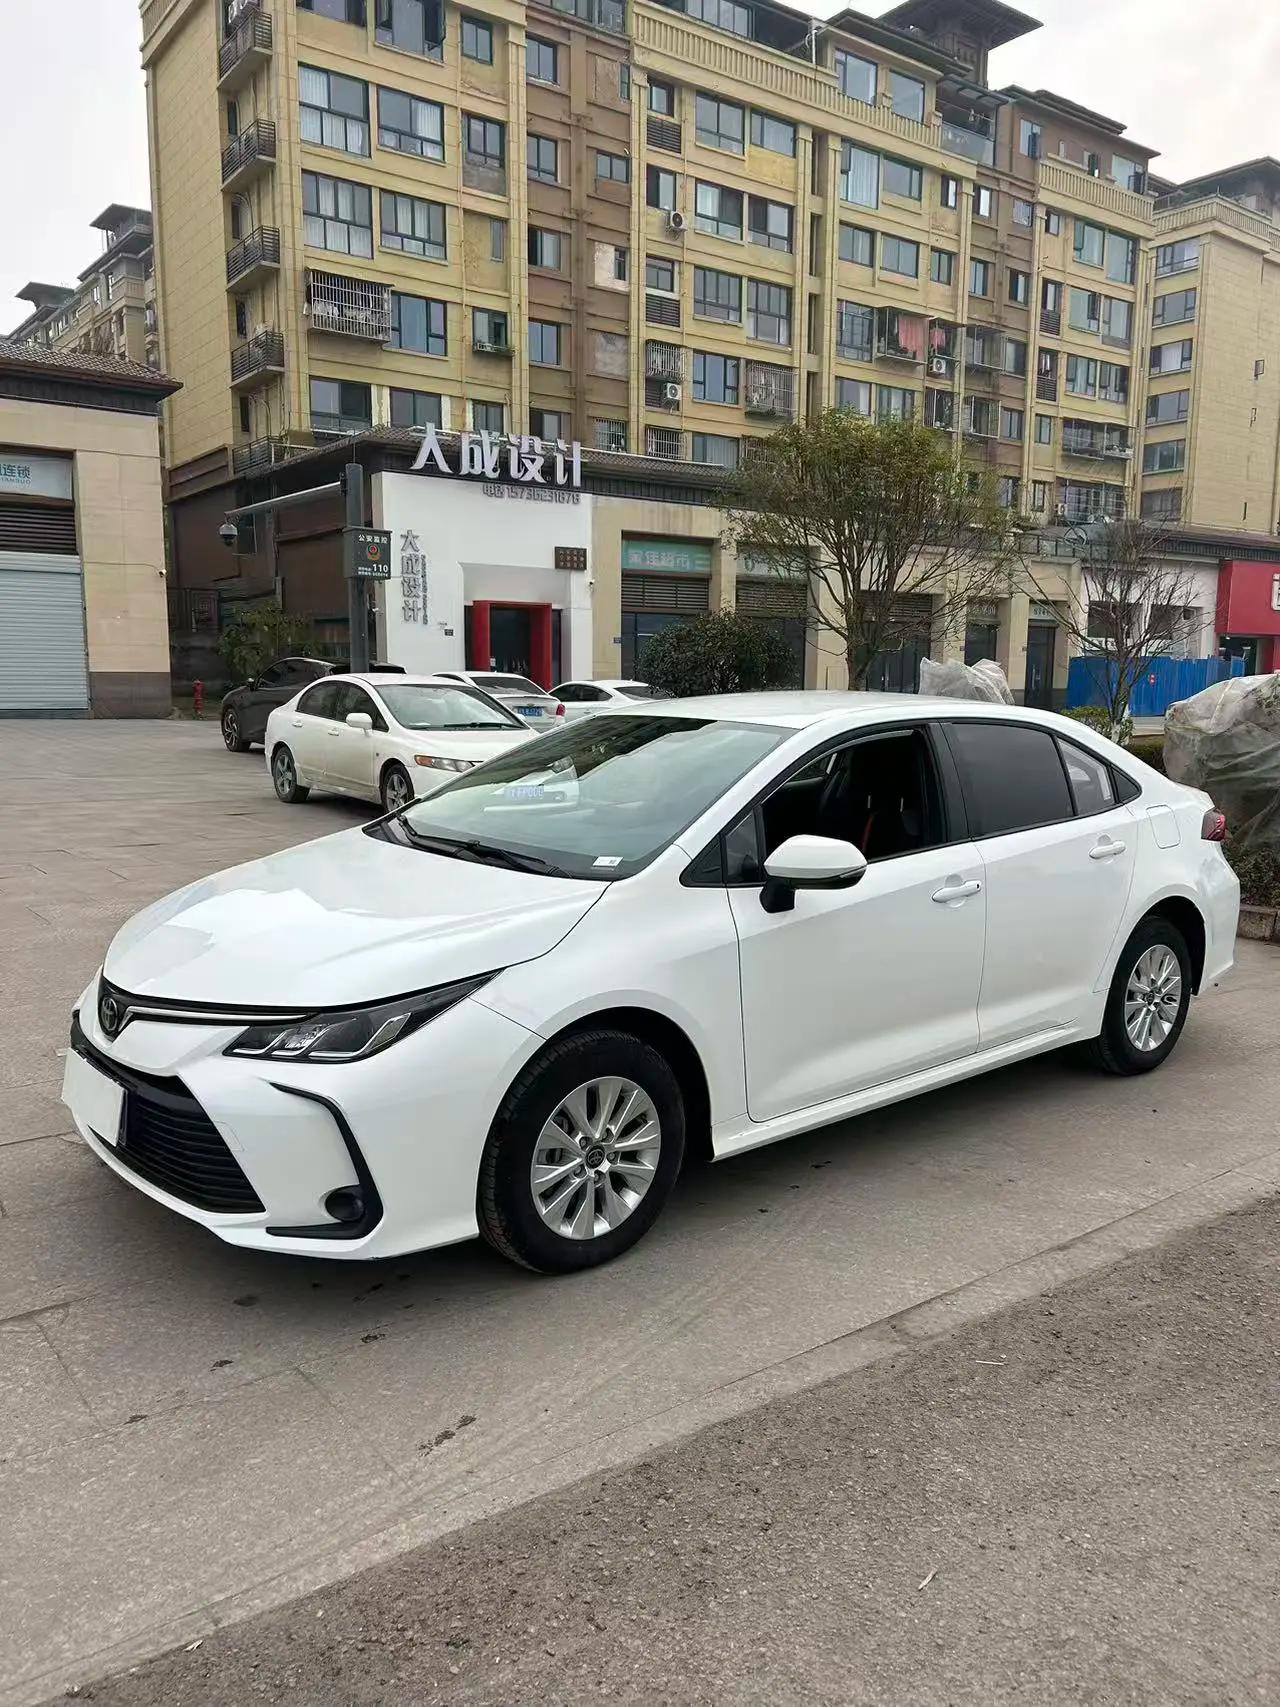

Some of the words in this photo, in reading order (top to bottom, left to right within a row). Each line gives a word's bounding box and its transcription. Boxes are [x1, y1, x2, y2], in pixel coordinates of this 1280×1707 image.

[0, 463, 31, 479] 连锁
[409, 422, 586, 487] 大成设计
[373, 564, 389, 573] 110
[400, 529, 422, 622] 大成设计
